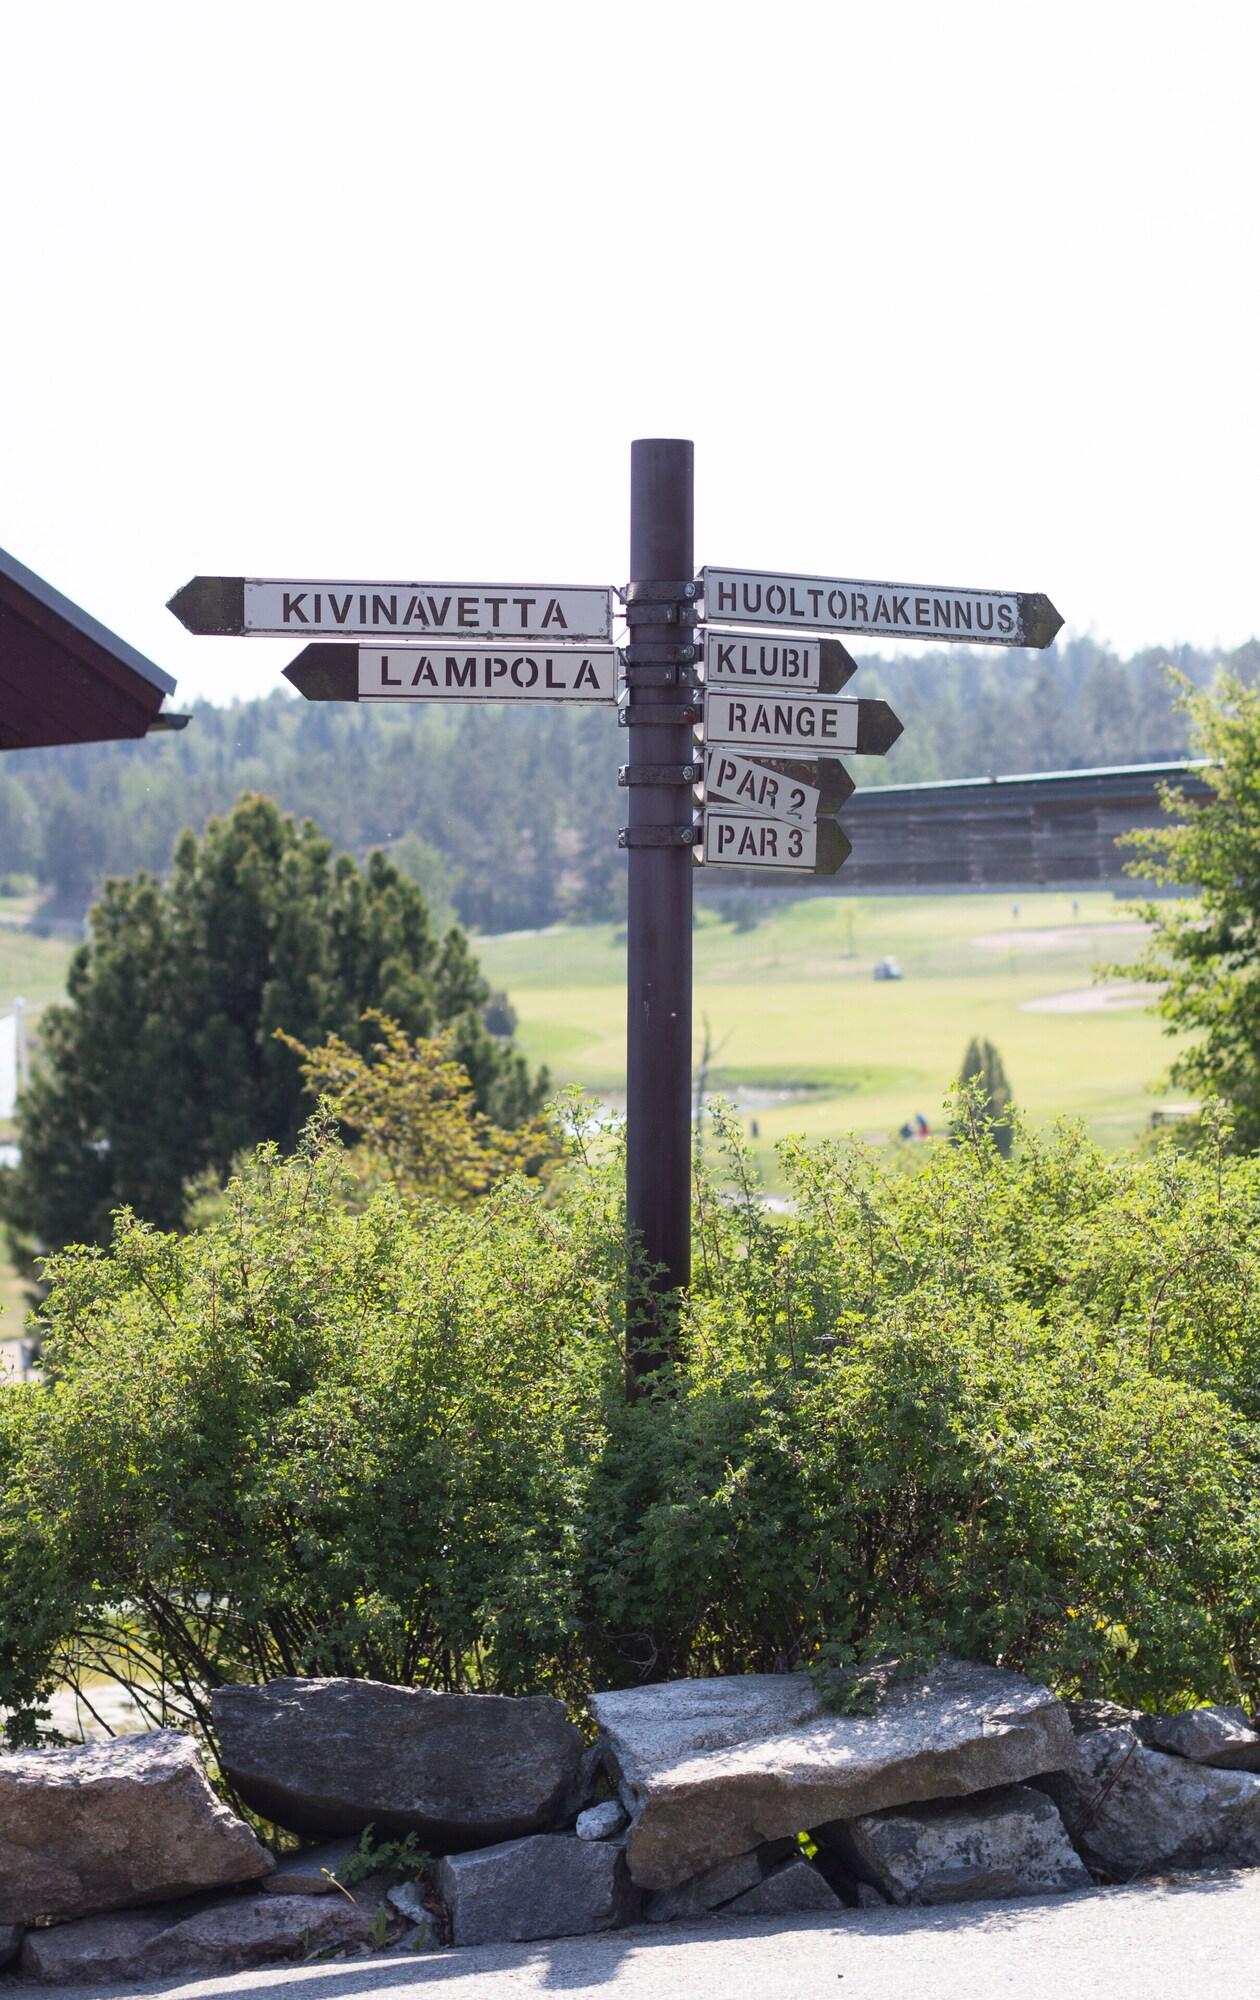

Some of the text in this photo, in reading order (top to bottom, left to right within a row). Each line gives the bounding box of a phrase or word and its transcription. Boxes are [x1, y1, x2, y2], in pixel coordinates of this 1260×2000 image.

[282, 592, 568, 629] KIVINAVETTA
[717, 581, 1013, 633] HUOLTORAKENNUS
[380, 656, 601, 690] LAMPOLA
[717, 643, 809, 679] KLUBI
[728, 702, 838, 738] RANGE
[716, 758, 806, 820] PAR 2
[718, 824, 803, 858] PAR 3
